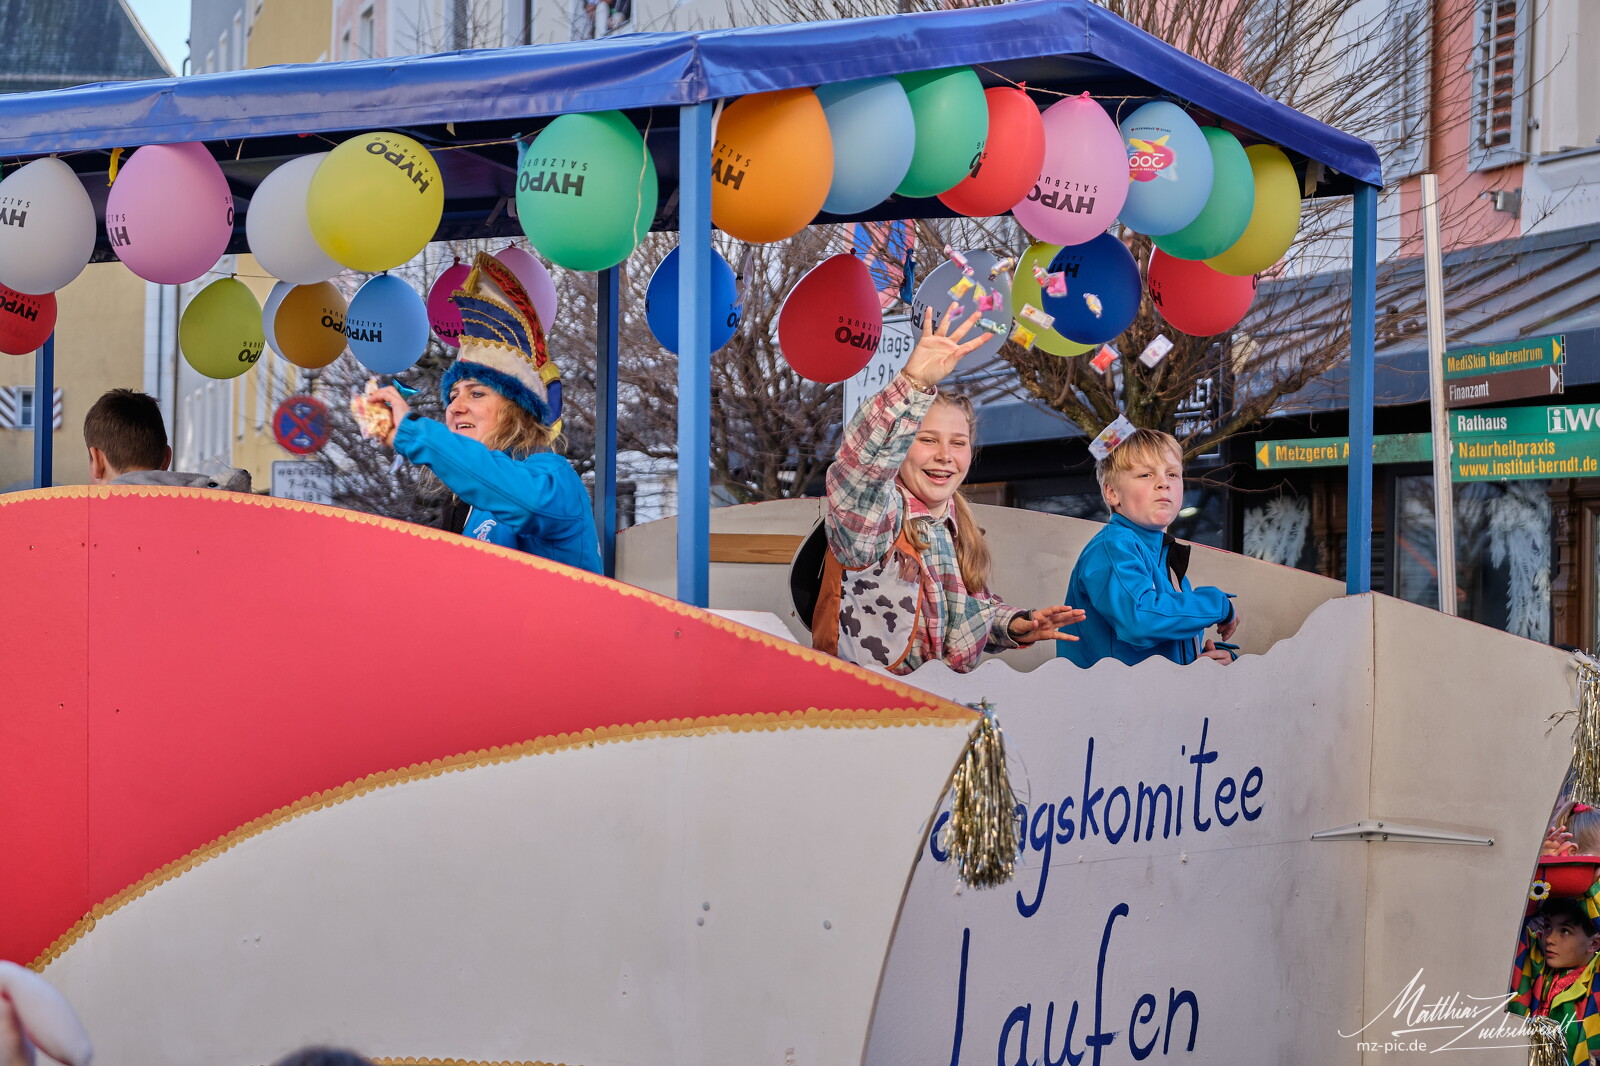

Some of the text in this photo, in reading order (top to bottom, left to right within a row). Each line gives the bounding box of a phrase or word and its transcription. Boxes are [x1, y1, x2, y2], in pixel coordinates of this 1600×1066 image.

[713, 140, 751, 168] SALZ
[365, 141, 430, 195] HYPO
[711, 156, 745, 190] HY
[519, 170, 585, 196] HYPO
[1038, 174, 1098, 194] SALZBU
[0, 197, 31, 208] SALZ
[1026, 184, 1096, 215] HYPO
[0, 207, 27, 228] HY
[109, 226, 131, 247] HY
[0, 296, 38, 322] HYPO
[321, 315, 348, 333] YPO
[834, 325, 880, 352] HYPO
[878, 334, 910, 358] tags
[1447, 347, 1543, 372] MediSkin Hautzentrum
[1449, 381, 1489, 400] Finanzamt
[1457, 414, 1508, 432] Rathaus
[1275, 443, 1338, 462] Metzgerei
[1458, 439, 1556, 459] Naturheilpraxis
[1459, 456, 1598, 476] www.institut-berndt.de
